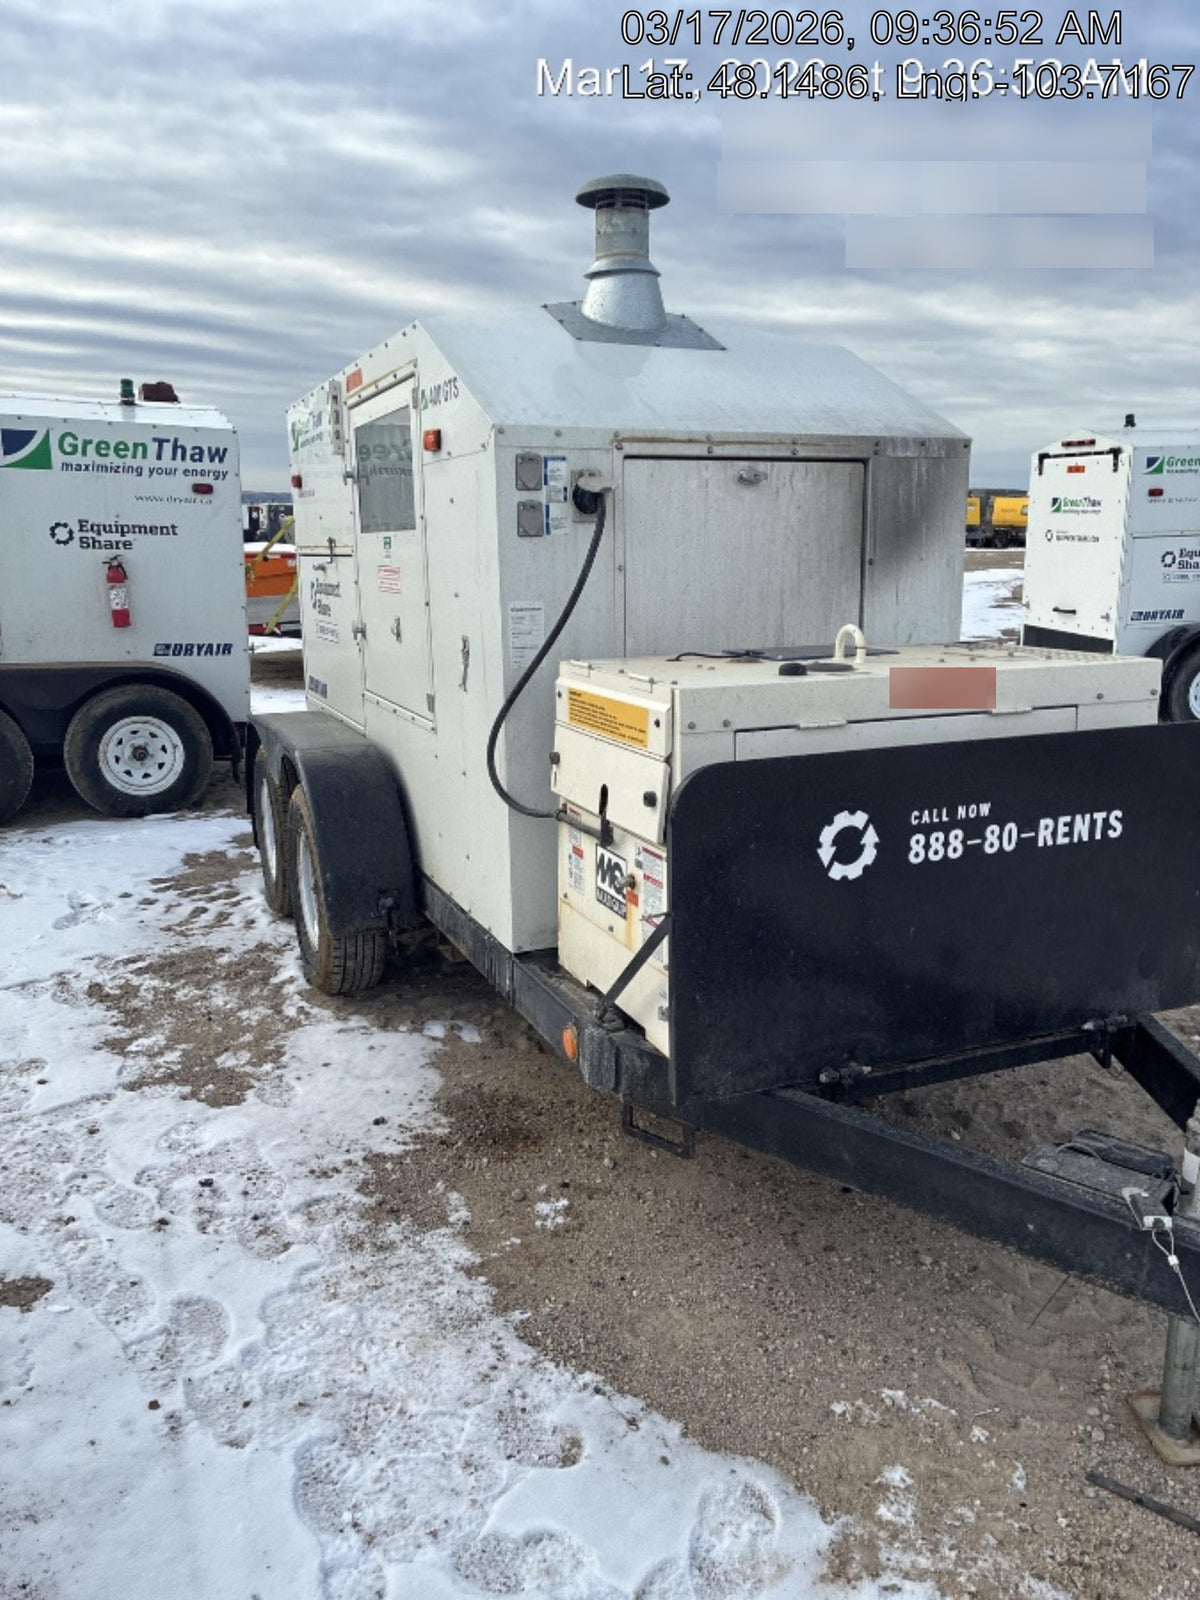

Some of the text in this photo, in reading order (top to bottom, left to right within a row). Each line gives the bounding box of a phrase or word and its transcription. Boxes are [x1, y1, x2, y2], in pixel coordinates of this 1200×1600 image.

[57, 431, 229, 464] GreenThaw
[61, 461, 229, 481] maximizing your energy
[77, 519, 179, 537] Equipment
[79, 536, 134, 550] Share
[171, 643, 234, 657] DRYAIR
[910, 802, 991, 826] CALL NOW
[908, 809, 1124, 865] 888-80-RENTS
